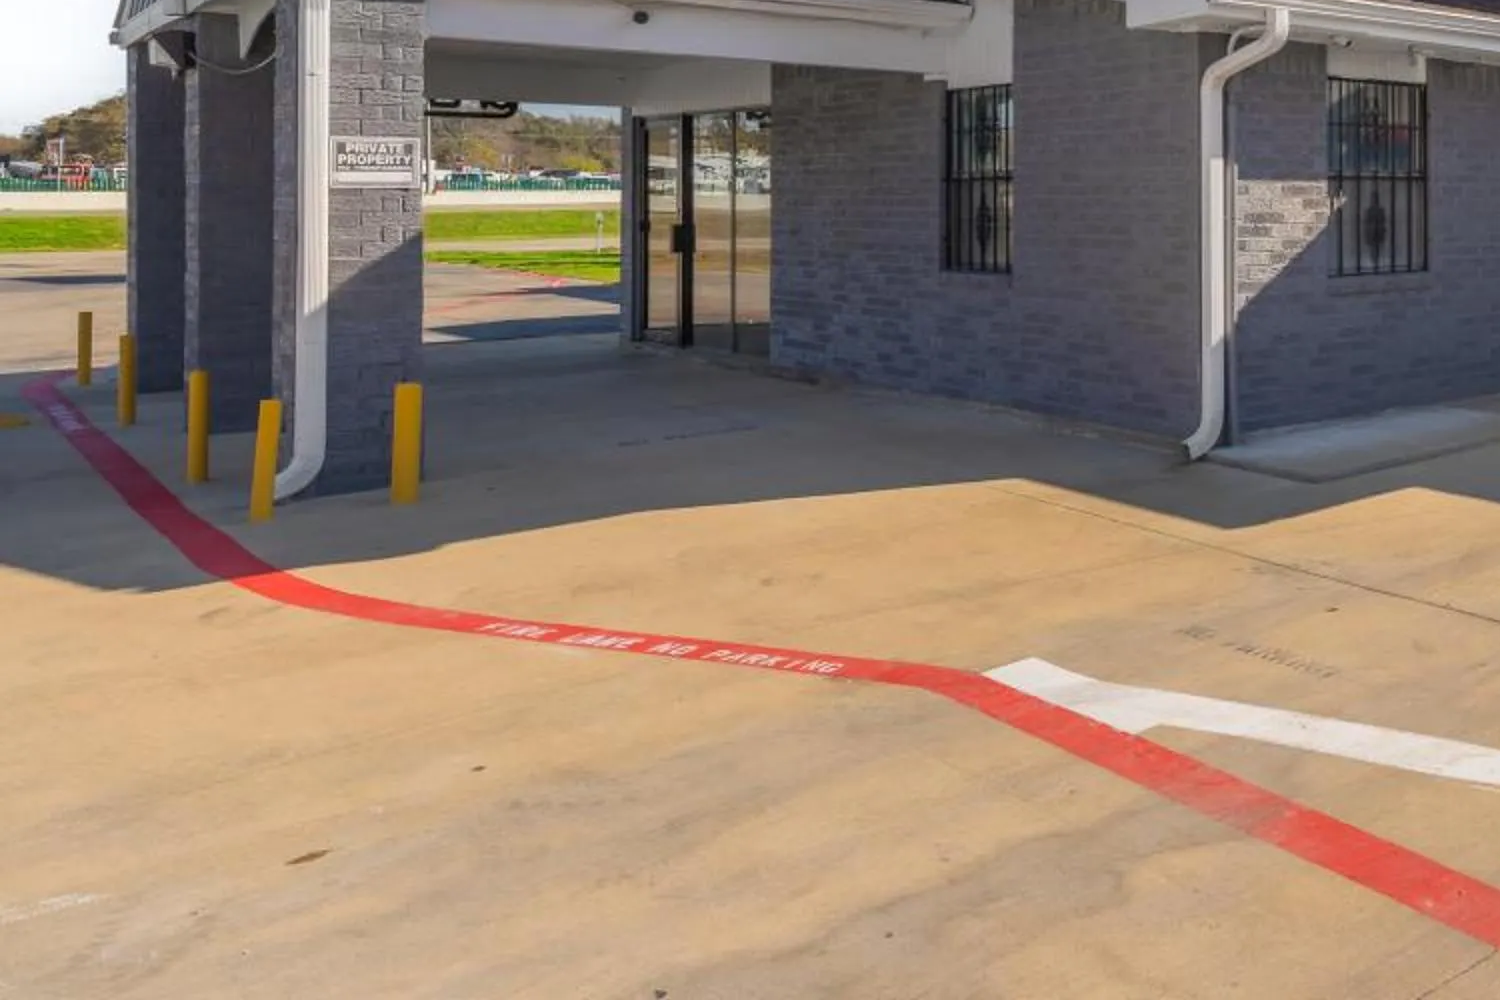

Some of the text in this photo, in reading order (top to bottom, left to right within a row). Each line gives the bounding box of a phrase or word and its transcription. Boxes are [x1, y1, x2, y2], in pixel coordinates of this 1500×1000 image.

[345, 142, 404, 155] PRIVATE
[337, 153, 412, 165] PROPERTY
[479, 622, 559, 639] FIRE
[558, 632, 646, 649] LANE
[646, 641, 698, 656] NO
